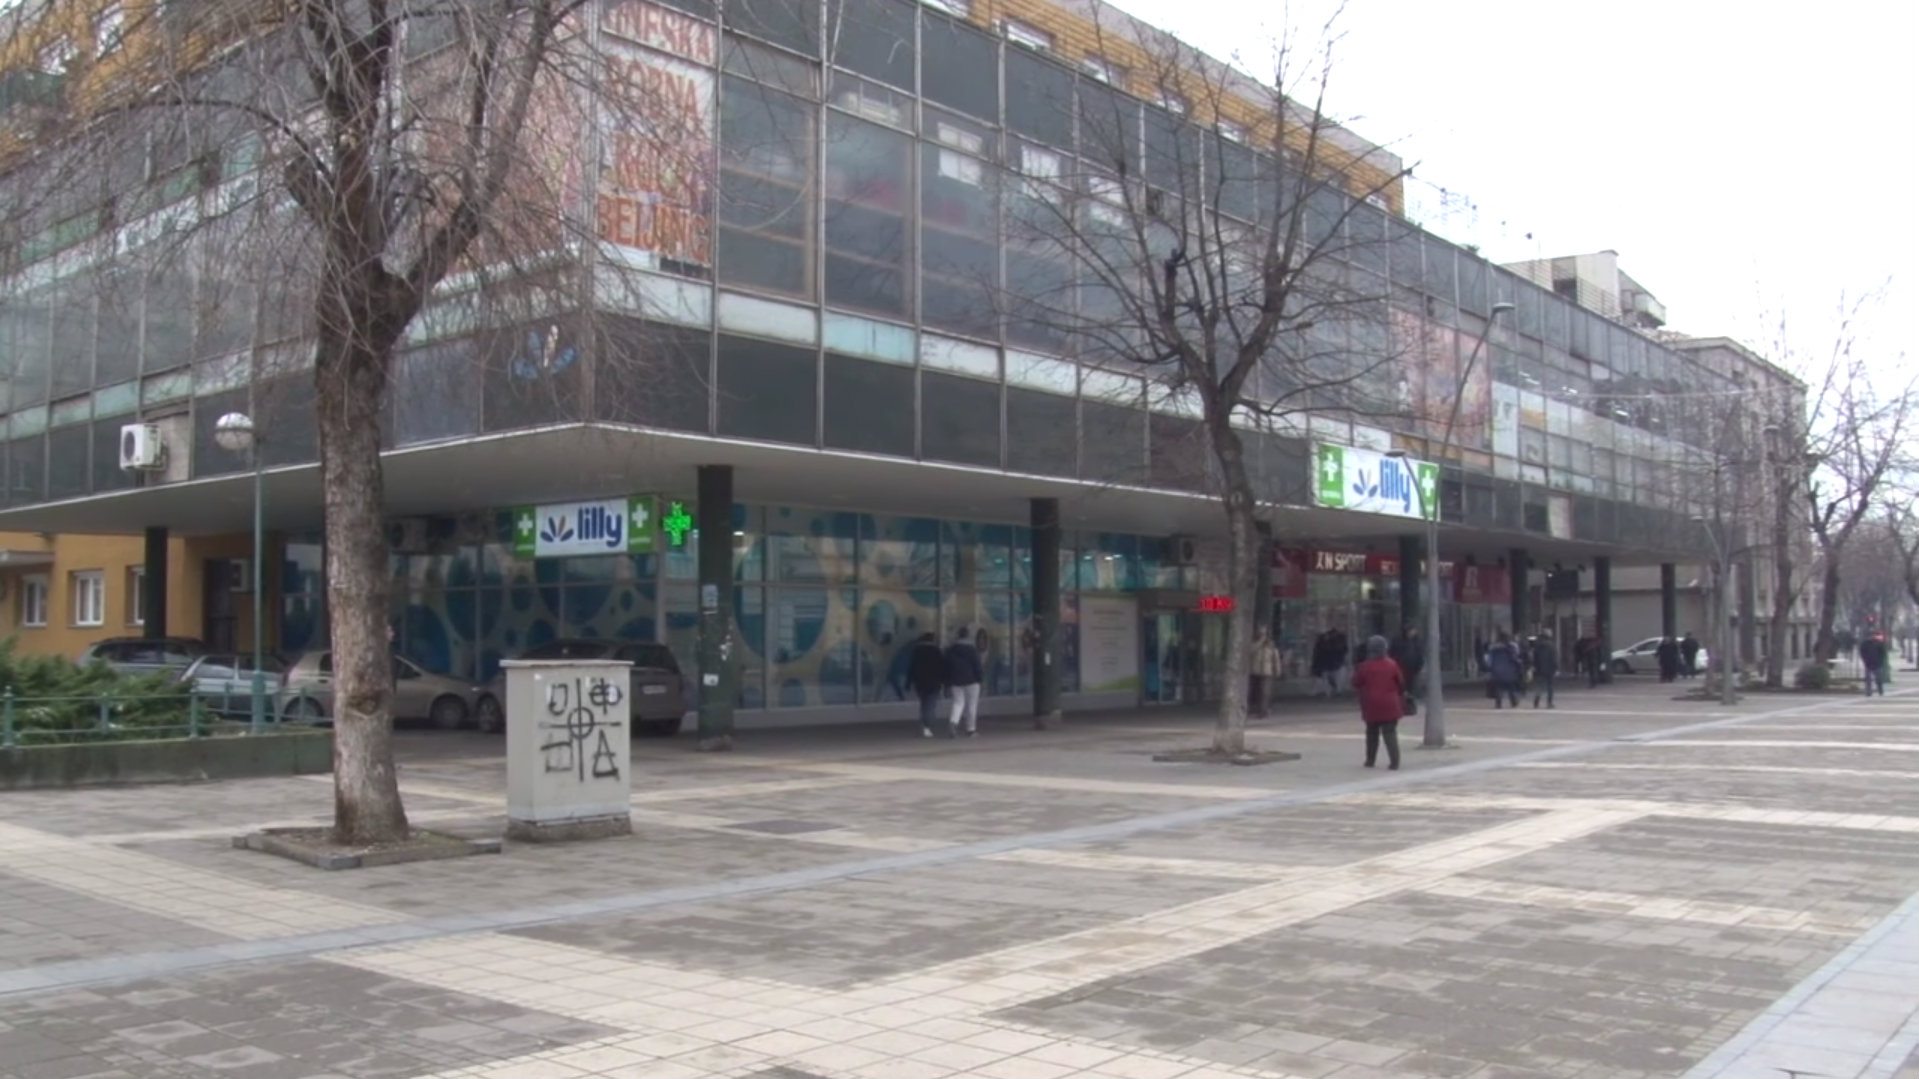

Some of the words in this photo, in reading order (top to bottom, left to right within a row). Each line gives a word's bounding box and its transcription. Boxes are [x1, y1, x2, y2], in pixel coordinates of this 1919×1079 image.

[1380, 458, 1411, 513] lilly
[578, 506, 622, 548] lilly
[1335, 552, 1366, 572] SPORT
